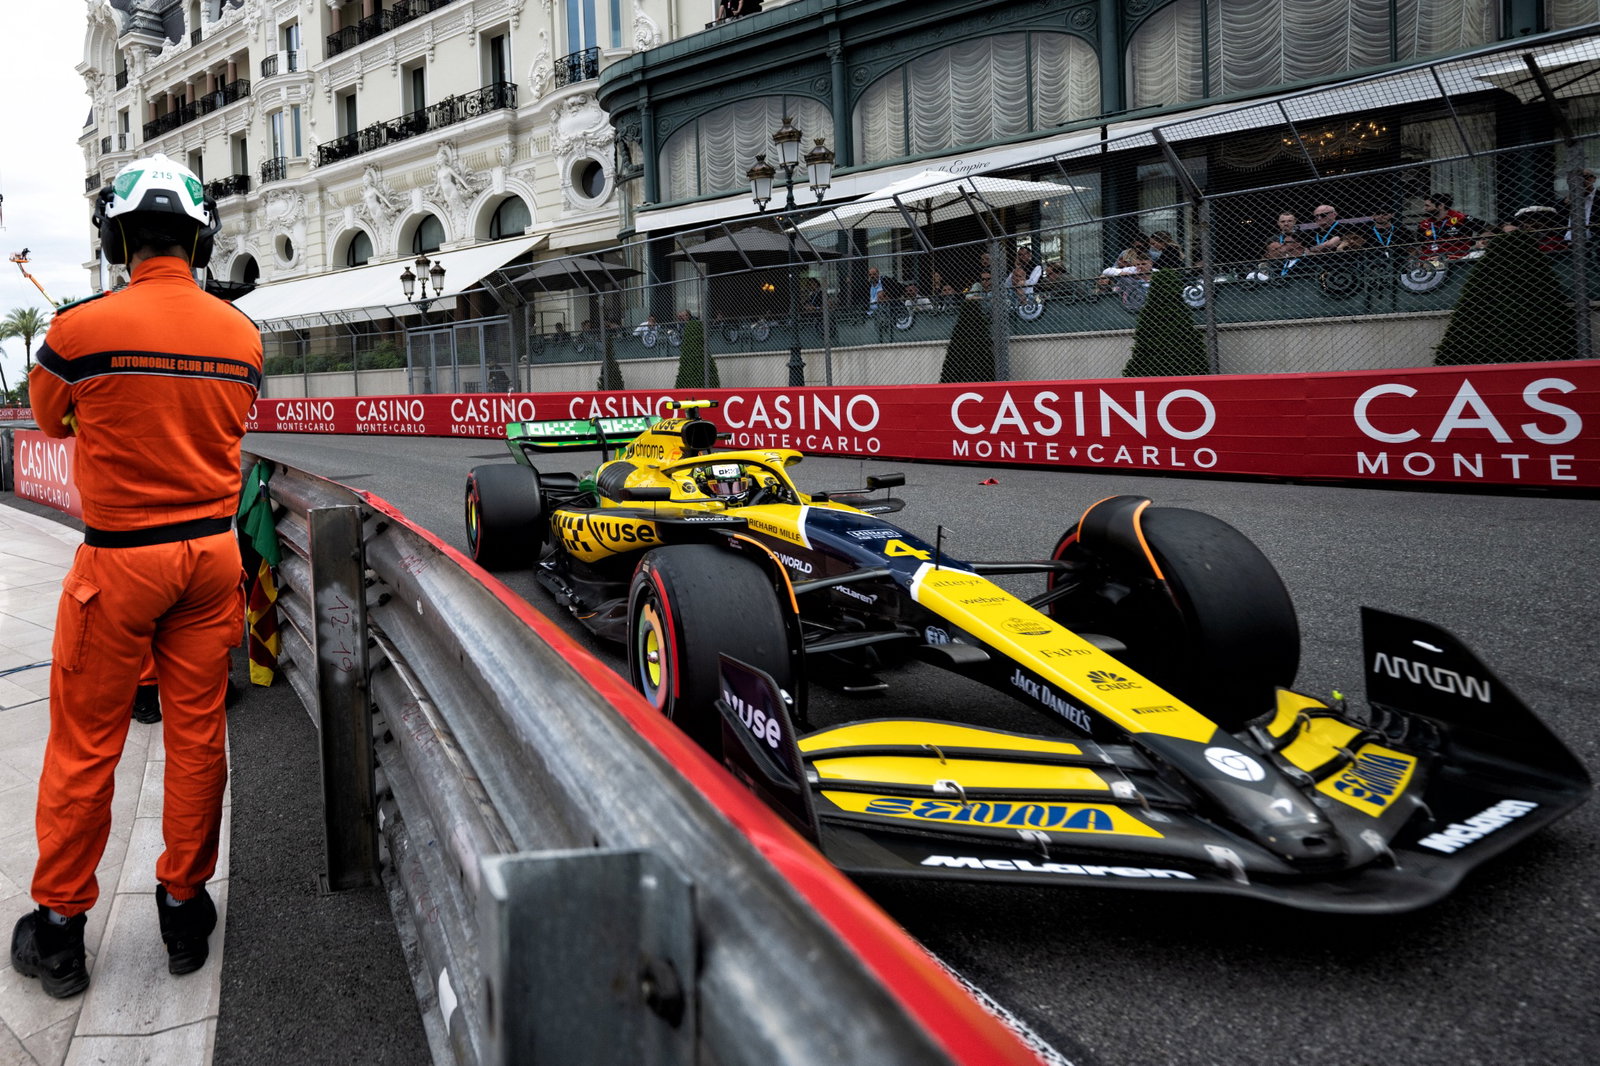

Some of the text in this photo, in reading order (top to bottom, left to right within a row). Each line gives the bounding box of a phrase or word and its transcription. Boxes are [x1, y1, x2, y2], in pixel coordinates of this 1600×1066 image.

[152, 171, 173, 180] 215
[949, 160, 991, 175] Empire
[111, 356, 249, 377] AUTOMOBILE CLUB DE MONACO
[276, 401, 335, 421] CASINO
[356, 399, 425, 421] CASINO
[451, 398, 535, 422] CASINO
[723, 393, 880, 432] CASINO
[951, 388, 1216, 440] CASINO
[277, 422, 335, 431] MONTE CARLO
[356, 423, 425, 433] MONTE CARLO
[452, 424, 489, 435] MONTE
[635, 440, 664, 460] chrome
[724, 432, 881, 453] MONTE CARLO
[20, 440, 68, 486] CASINO
[952, 439, 1218, 468] MONTE CARLO
[1356, 451, 1578, 481] MONTE
[21, 480, 71, 509] MONTE CARLO
[748, 518, 800, 542] RICHARD MILLE
[884, 539, 932, 560] 4
[780, 554, 812, 574] WORLD
[960, 596, 1010, 605] webex
[925, 628, 948, 646] FIA
[1039, 648, 1093, 658] FxPro
[1096, 682, 1143, 692] CNBC
[1010, 669, 1093, 735] JACK DANIEL'S
[865, 798, 1113, 832] SENNA
[1417, 798, 1539, 854] McLaren
[921, 855, 1197, 880] McLaren
